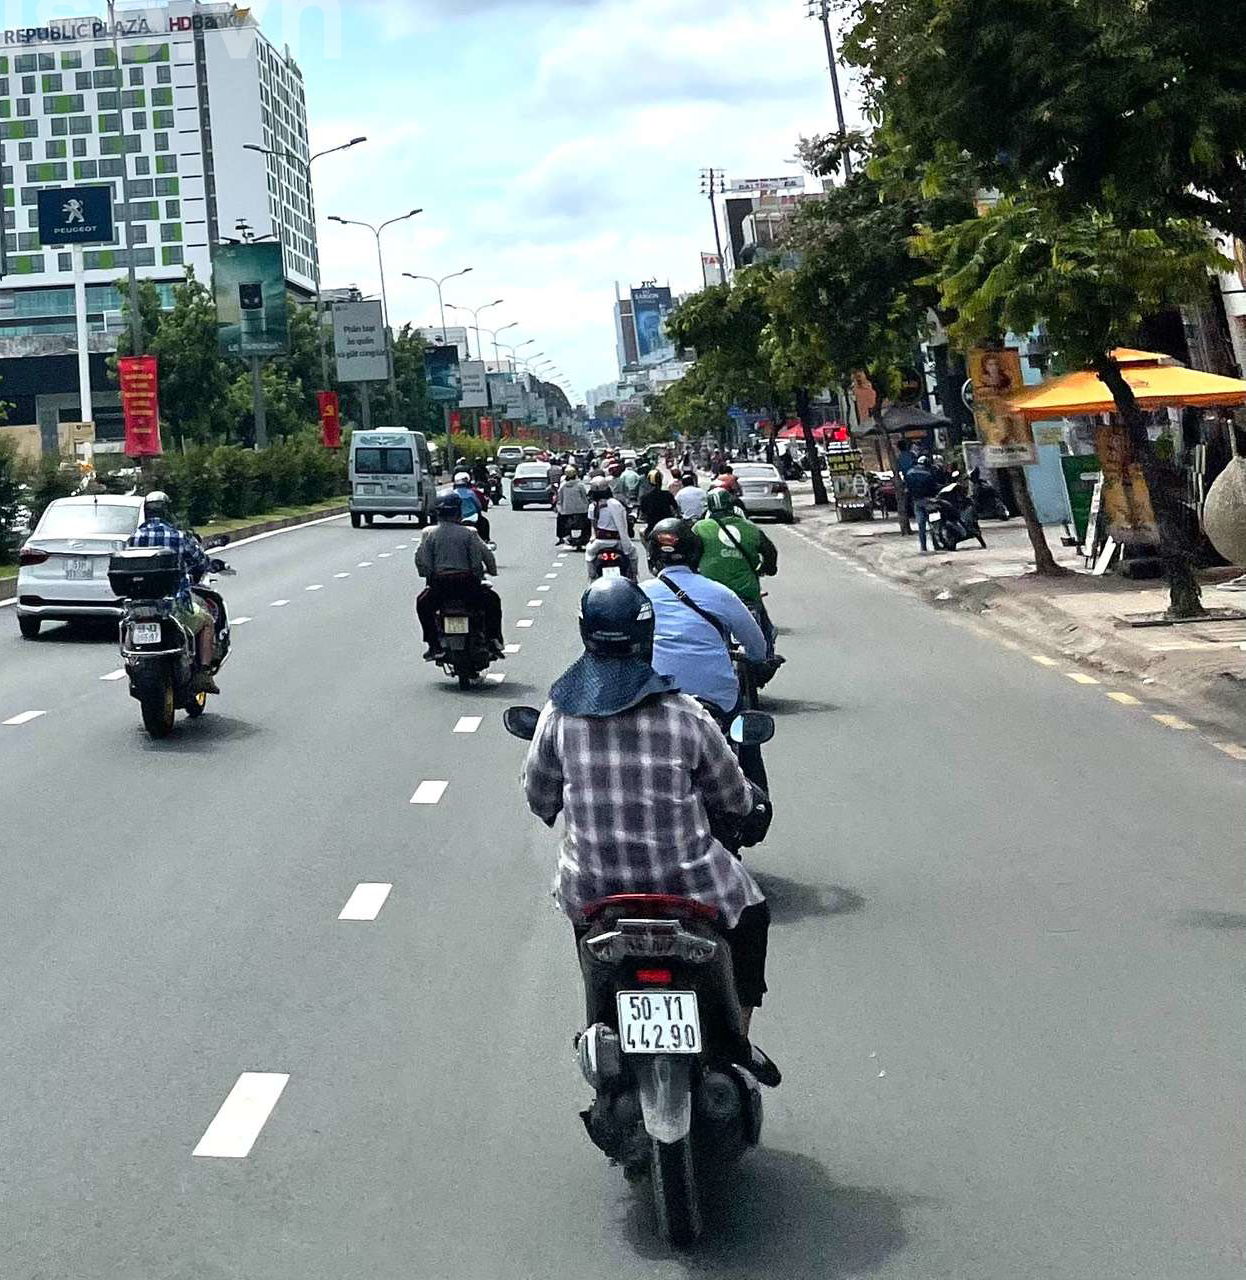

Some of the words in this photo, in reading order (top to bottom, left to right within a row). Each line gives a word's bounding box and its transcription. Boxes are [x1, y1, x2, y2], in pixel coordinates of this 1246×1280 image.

[4, 23, 88, 44] REPUBLIC
[92, 18, 149, 38] PLAZA
[169, 13, 234, 32] HDBank
[53, 225, 98, 235] PEUGEOT
[629, 996, 683, 1021] 50-Y1
[627, 1024, 696, 1049] 442.90
